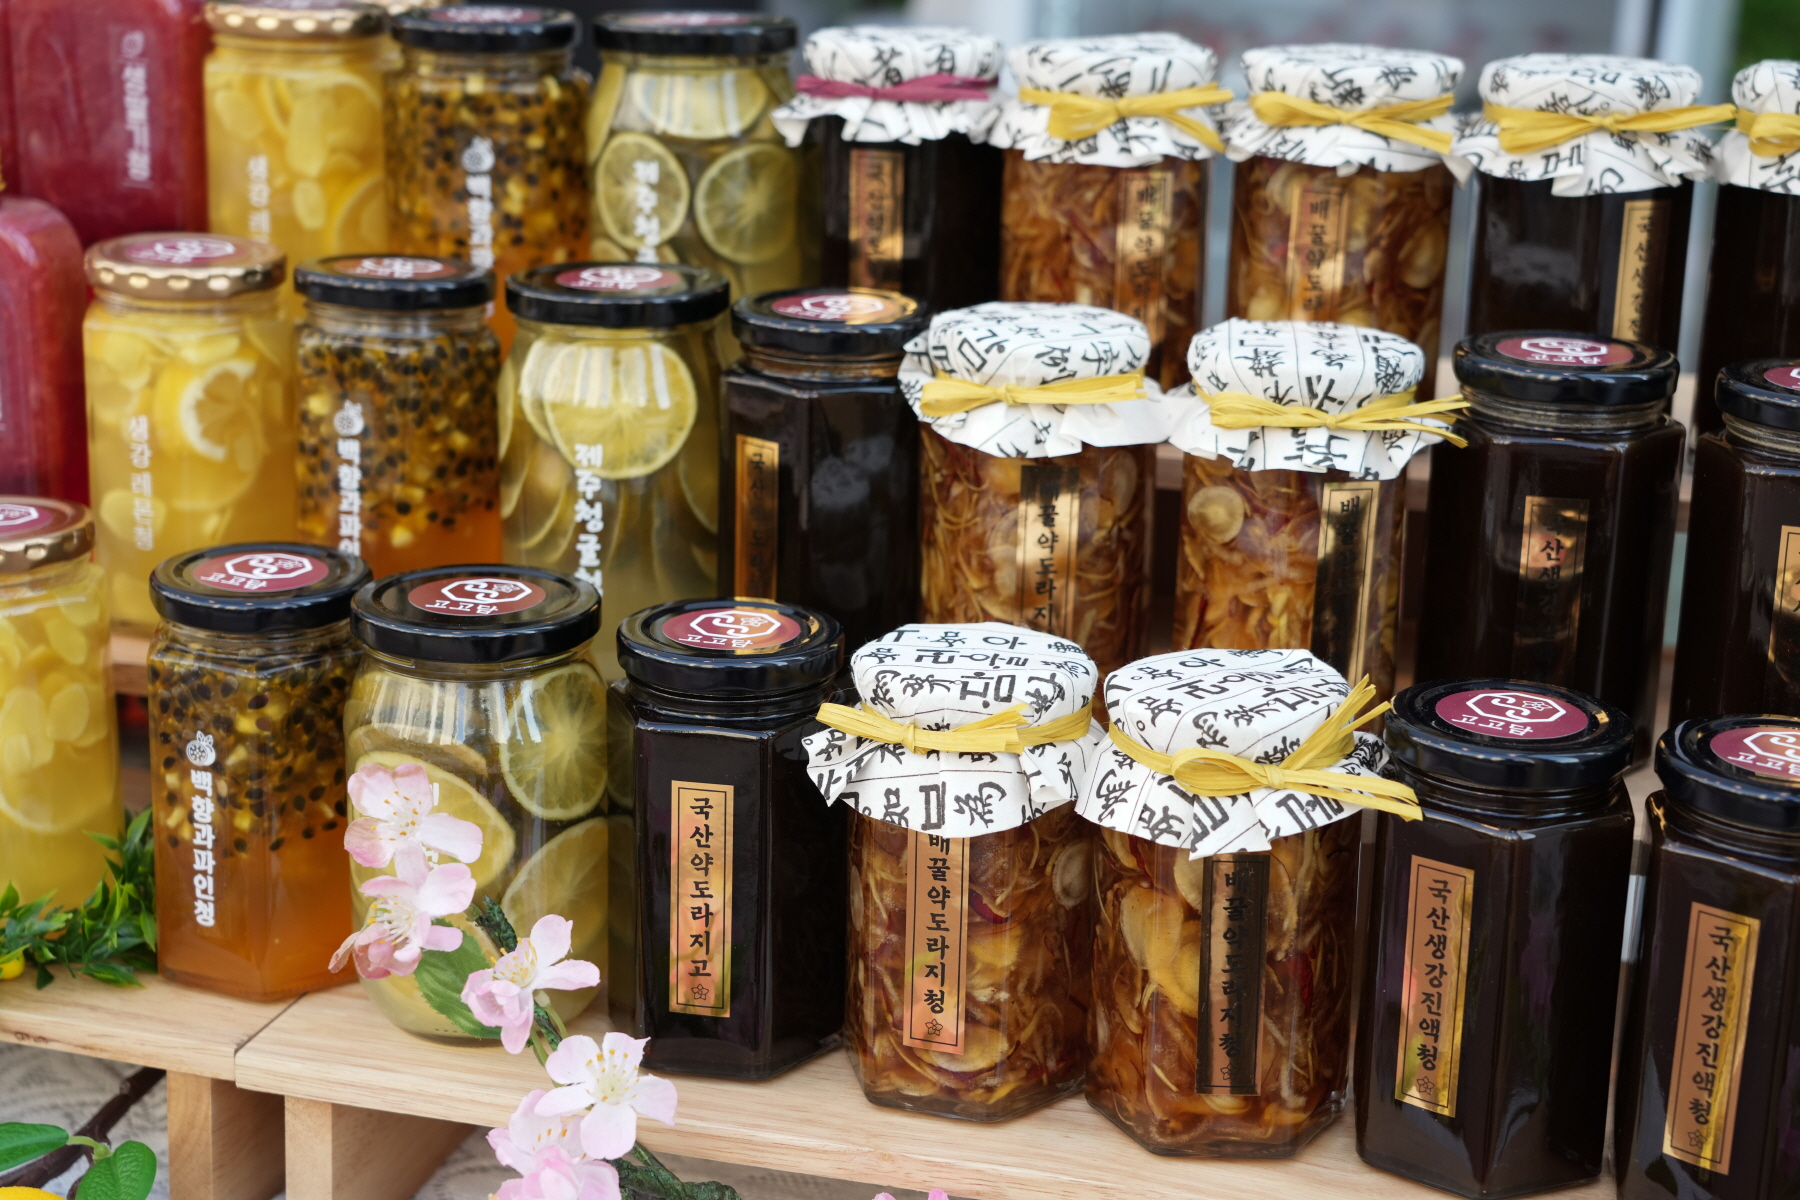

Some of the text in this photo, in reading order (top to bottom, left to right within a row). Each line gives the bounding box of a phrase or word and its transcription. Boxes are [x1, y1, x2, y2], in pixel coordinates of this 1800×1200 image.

[202, 572, 267, 590] 고고담
[425, 600, 498, 615] 고고담
[678, 634, 754, 648] 고고담
[1451, 714, 1534, 737] 고고담
[190, 769, 216, 928] 백향과파인청
[687, 797, 714, 977] 국산약도라지고
[923, 833, 951, 1014] 배꿀약도라지청
[1219, 868, 1248, 1058] 배꿀약도라지청
[1416, 878, 1452, 1072] 국산생강진액청
[1688, 925, 1734, 1126] 국산생강진액청
